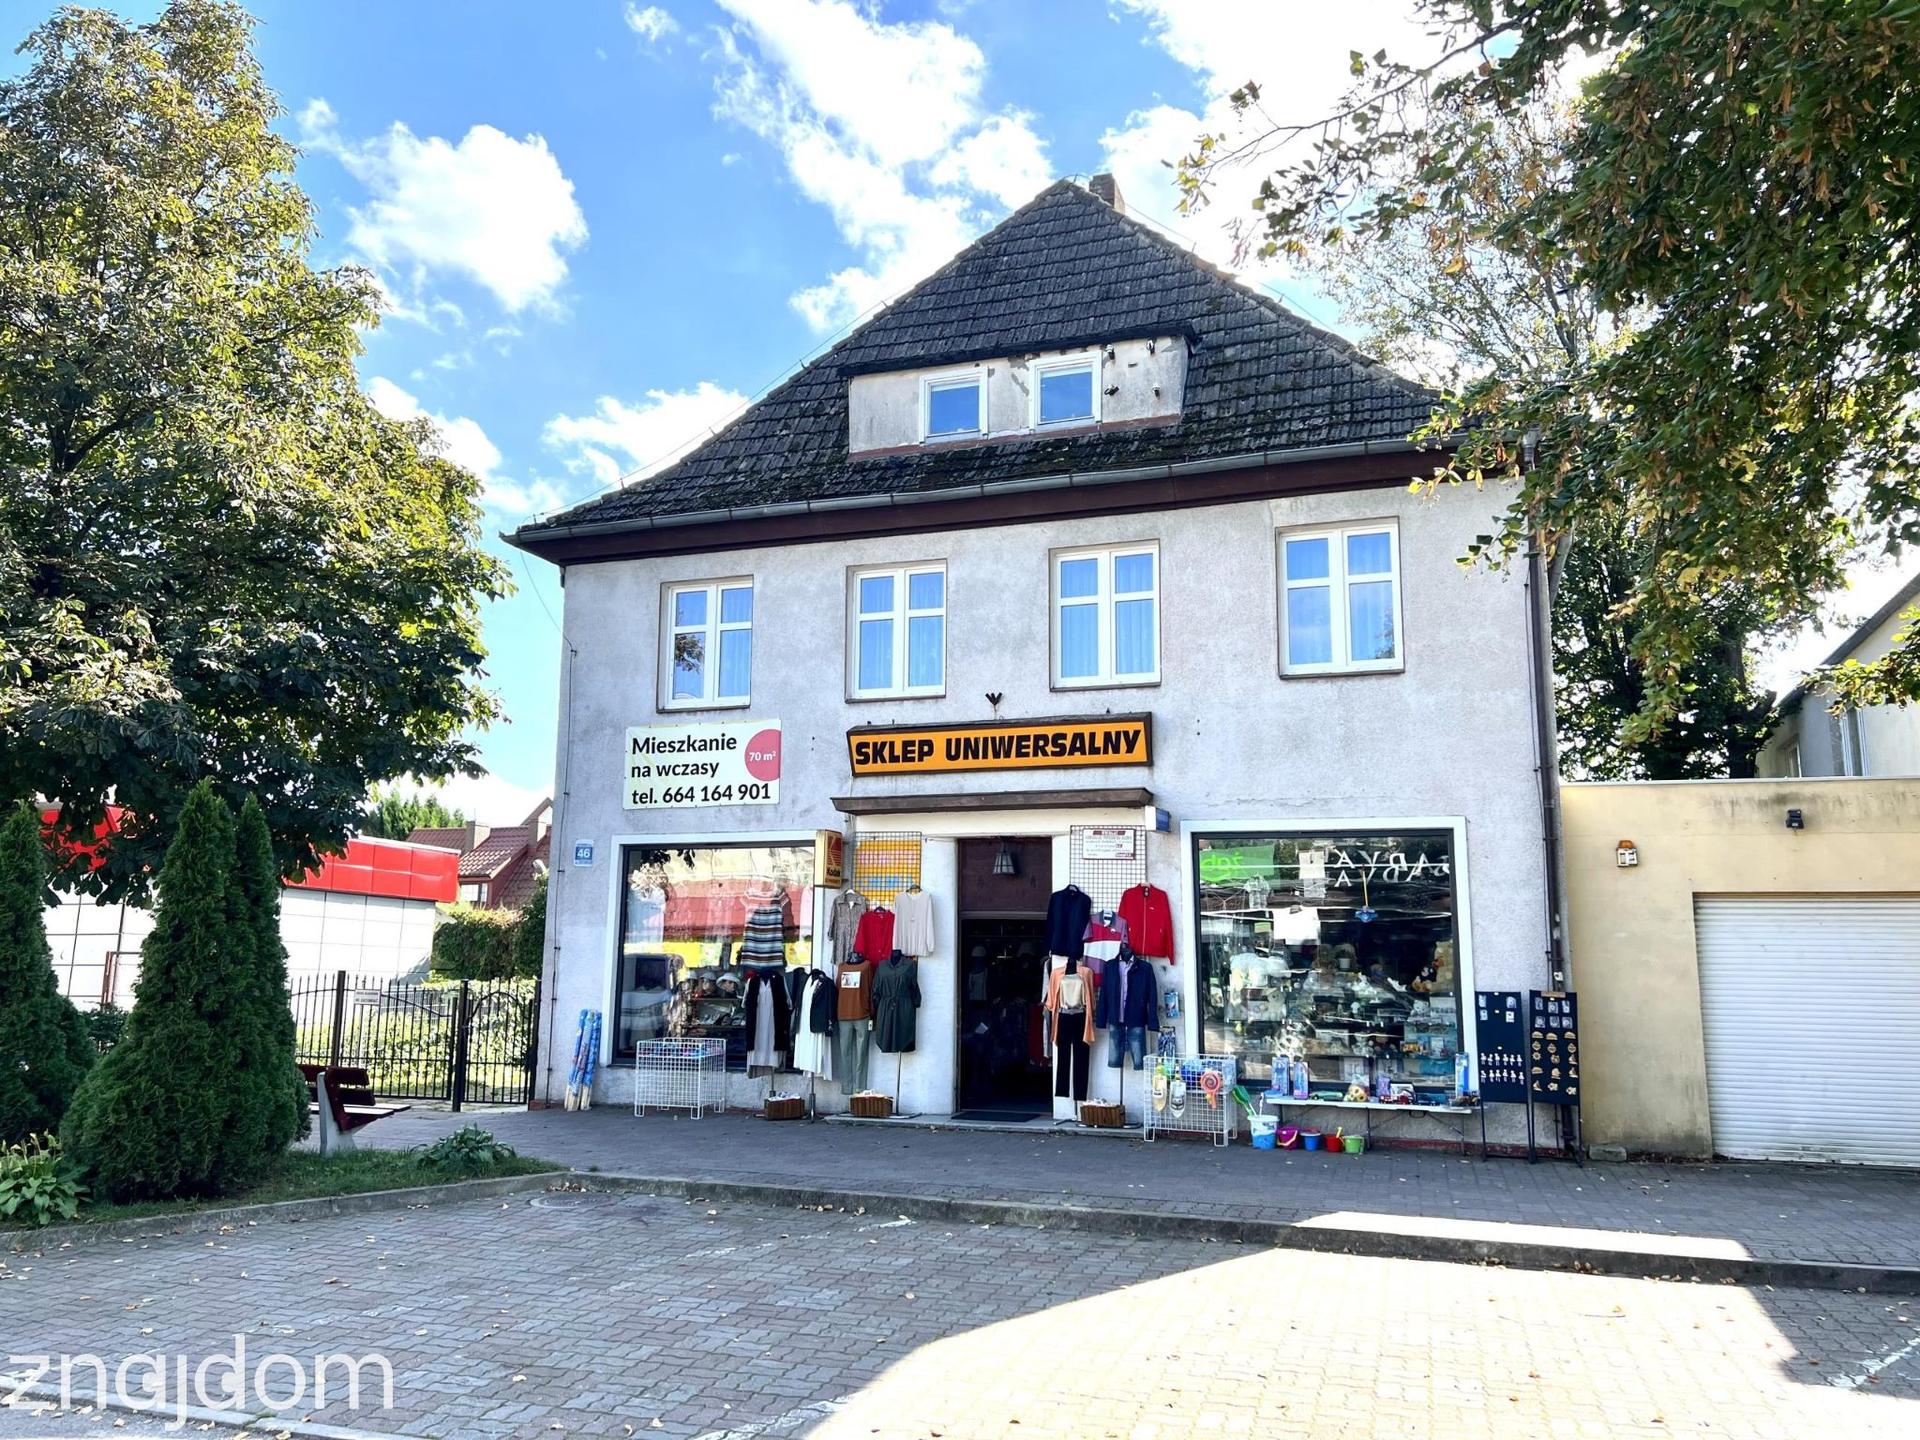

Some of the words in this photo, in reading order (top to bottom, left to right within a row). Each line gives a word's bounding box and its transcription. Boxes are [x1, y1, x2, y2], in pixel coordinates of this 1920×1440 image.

[632, 733, 737, 754] Mieszkanie
[855, 740, 934, 765] SKLEP
[945, 729, 1141, 761] UNIWERSALNY
[749, 752, 761, 761] 70
[631, 764, 651, 778] na
[656, 762, 719, 778] wczasy
[632, 788, 657, 804] tel.
[662, 786, 695, 803] 664
[701, 785, 732, 802] 164
[738, 783, 771, 800] 901
[577, 848, 591, 858] 46
